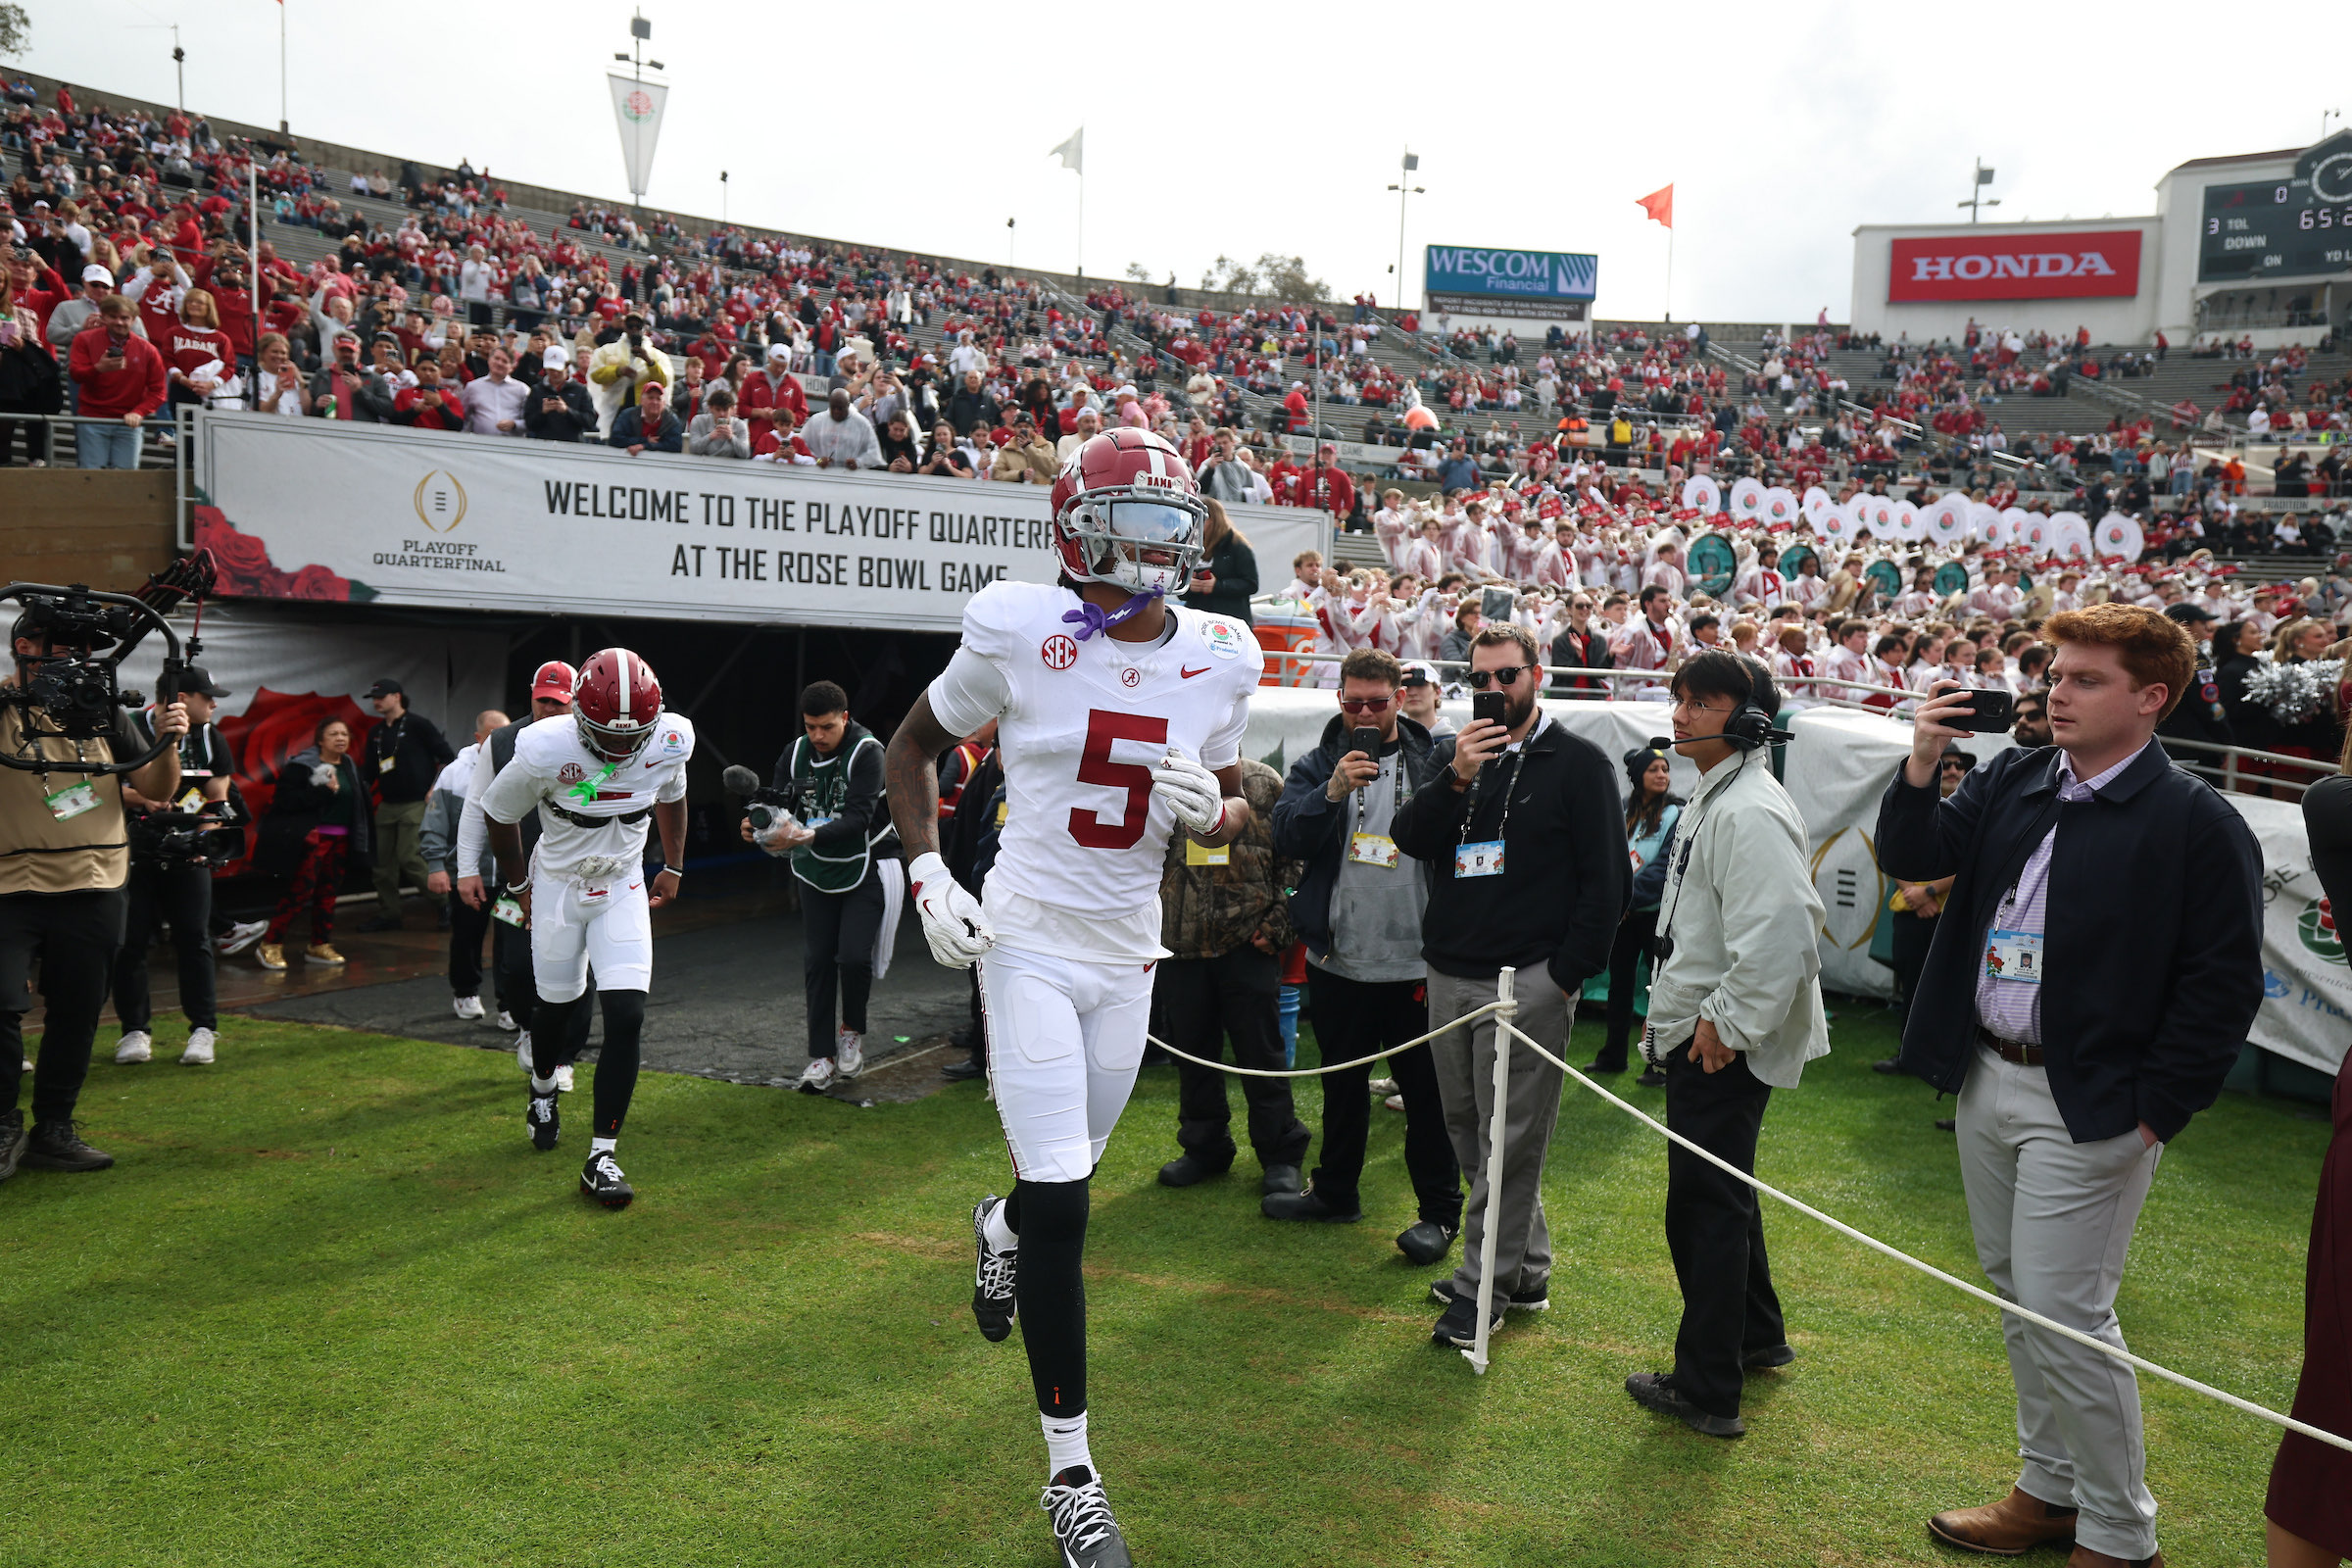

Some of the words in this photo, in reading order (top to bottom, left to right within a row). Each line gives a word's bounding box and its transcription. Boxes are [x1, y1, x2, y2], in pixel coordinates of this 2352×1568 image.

[2208, 218, 2220, 235] 3
[2227, 218, 2250, 230] TOL
[2224, 234, 2267, 251] DOWN
[1431, 247, 1550, 278] WESCOM
[2264, 254, 2282, 268] ON
[2325, 249, 2342, 263] YD
[1911, 251, 2117, 281] HONDA
[1486, 275, 1549, 292] Financial
[1433, 296, 1462, 305] REPORT
[1463, 297, 1502, 308] INCIDENTS
[1531, 302, 1580, 311] MISCONDUCT
[1538, 310, 1568, 319] DETAILS
[806, 377, 827, 393] HON
[1148, 476, 1172, 489] BAMA
[544, 479, 689, 524] WELCOME
[699, 492, 734, 527] TO
[745, 496, 796, 531] THE
[806, 501, 920, 540] PLAYOFF
[930, 511, 1053, 550] QUARTERF
[402, 539, 478, 557] PLAYOFF
[372, 552, 506, 573] QUARTERFINAL
[671, 543, 707, 577] AT
[715, 546, 767, 581] THE
[778, 550, 848, 586] ROSE
[858, 555, 931, 591] BOWL
[1043, 636, 1077, 669] SEC
[562, 762, 582, 780] SEC
[1068, 708, 1169, 850] 5
[2264, 863, 2300, 909] OSE
